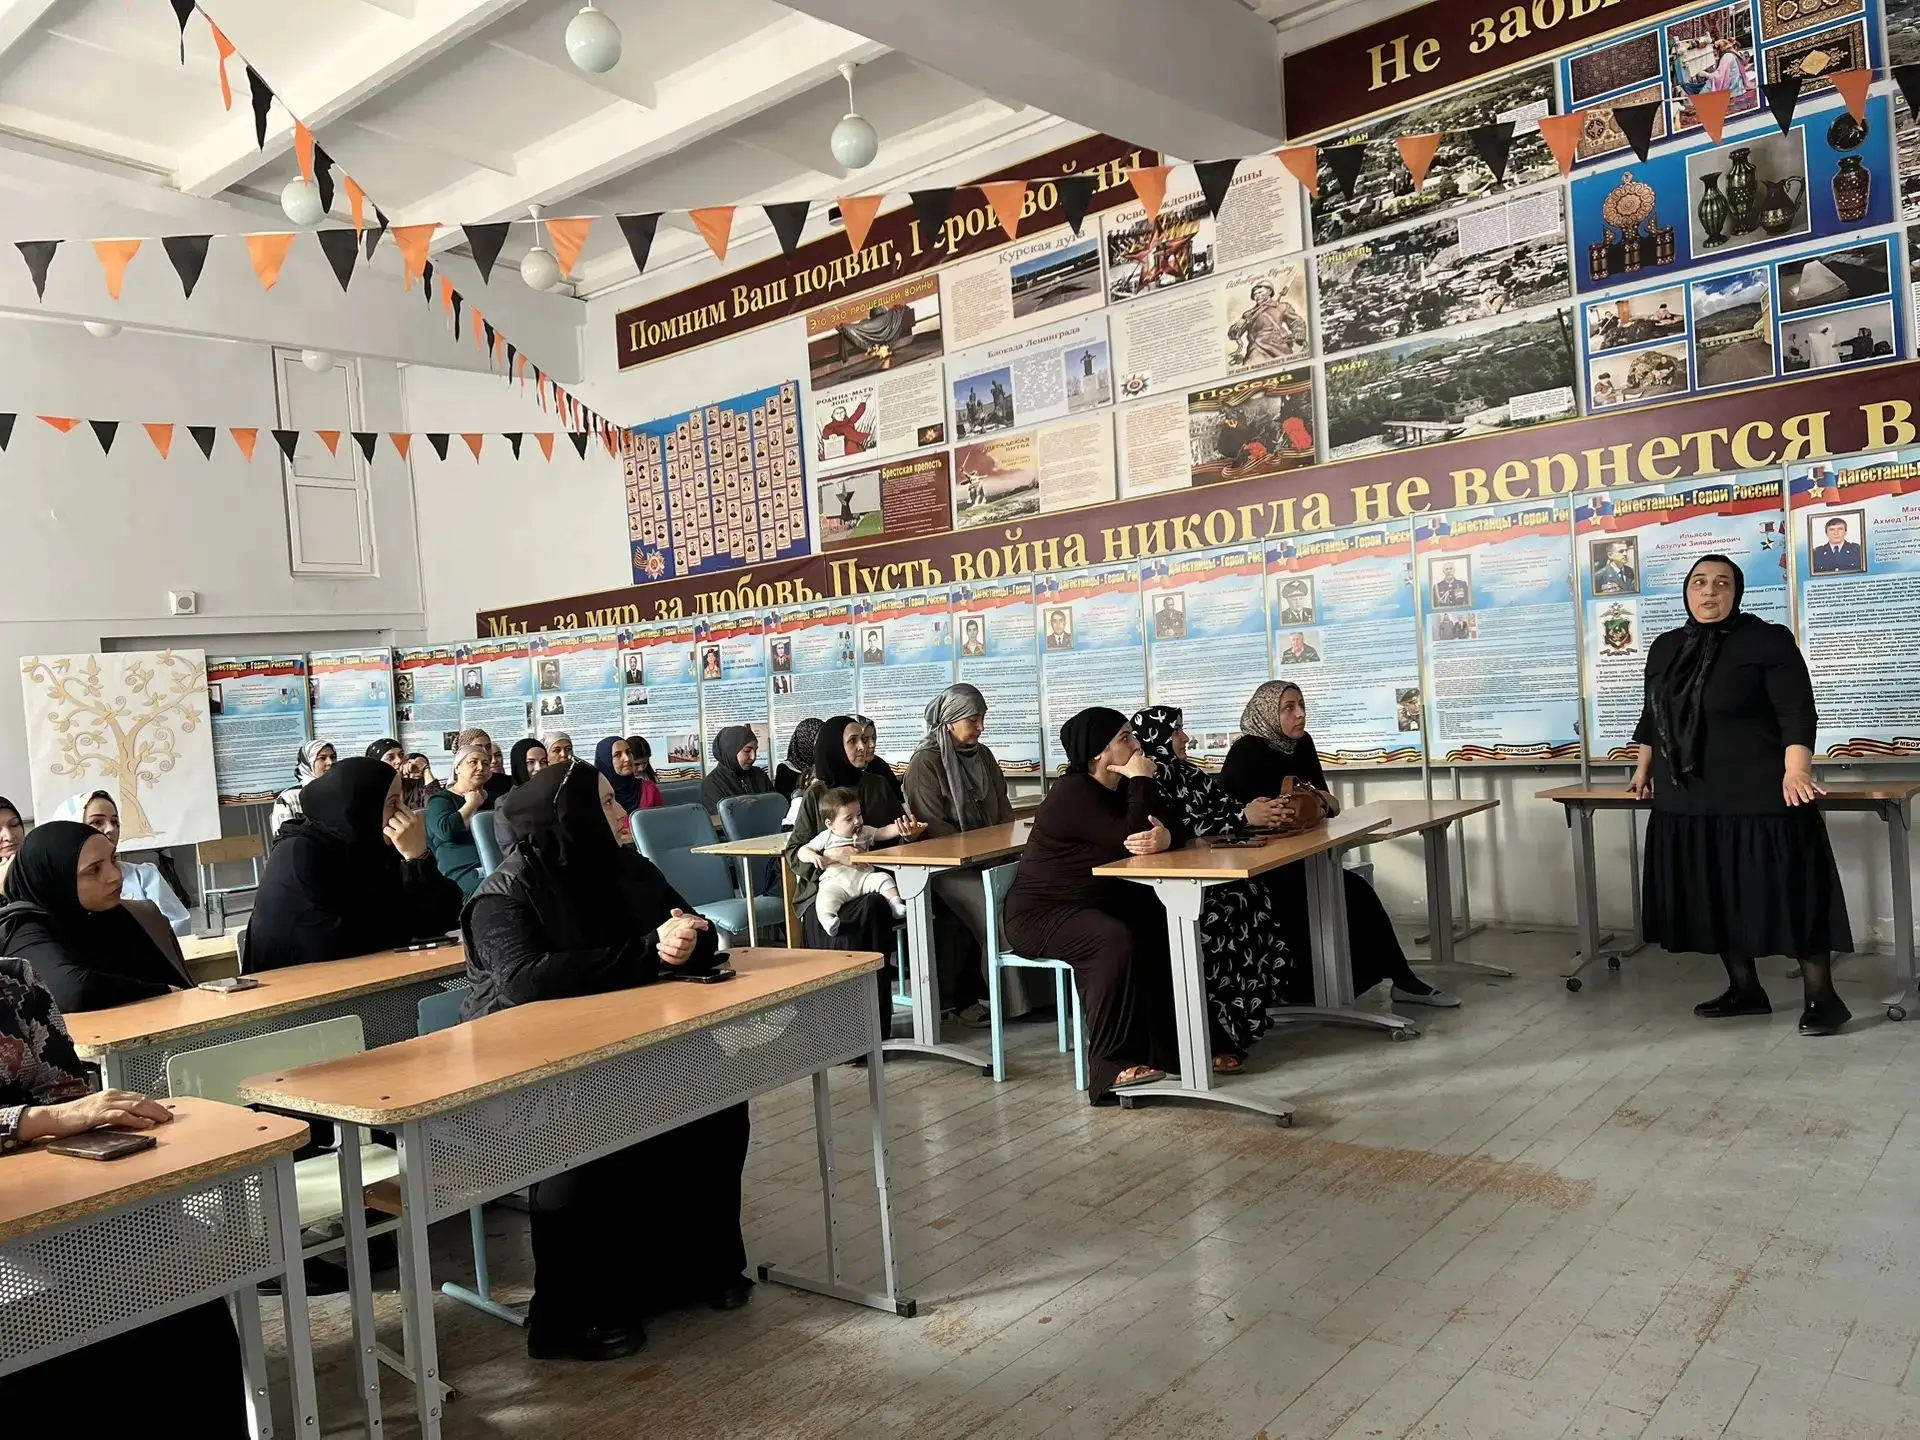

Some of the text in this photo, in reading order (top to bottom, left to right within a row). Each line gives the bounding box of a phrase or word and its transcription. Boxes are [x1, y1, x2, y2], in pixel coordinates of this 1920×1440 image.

[1366, 34, 1441, 92] Не
[998, 240, 1052, 265] Курская
[629, 303, 727, 351] Помним
[731, 278, 789, 318] Ваш
[793, 239, 903, 292] подвиг,
[988, 327, 1081, 359] Блокада Ленинграда
[1331, 359, 1369, 375] РАХАТА
[1199, 374, 1294, 401] Победа
[882, 459, 943, 480] Брестская крепость
[1614, 492, 1685, 516] Дагестанцы
[1693, 487, 1729, 506] Герои
[1734, 482, 1780, 500] России
[488, 615, 528, 637] Мы
[553, 612, 579, 631] за
[654, 597, 683, 621] за
[829, 556, 944, 597] Пусть
[950, 529, 1089, 584] война
[1101, 497, 1332, 562] никогда
[1350, 475, 1431, 519] не
[1448, 410, 1832, 511] вернется
[1863, 399, 1916, 451] в
[1450, 516, 1511, 536] Дагестанцы
[1518, 511, 1549, 526] Герои
[1873, 517, 1901, 525] Ахмед
[1296, 540, 1349, 559] Дагестанцы
[1355, 535, 1381, 549] Герои
[1168, 559, 1216, 576] Дагестанцы
[1221, 554, 1245, 567] Герои
